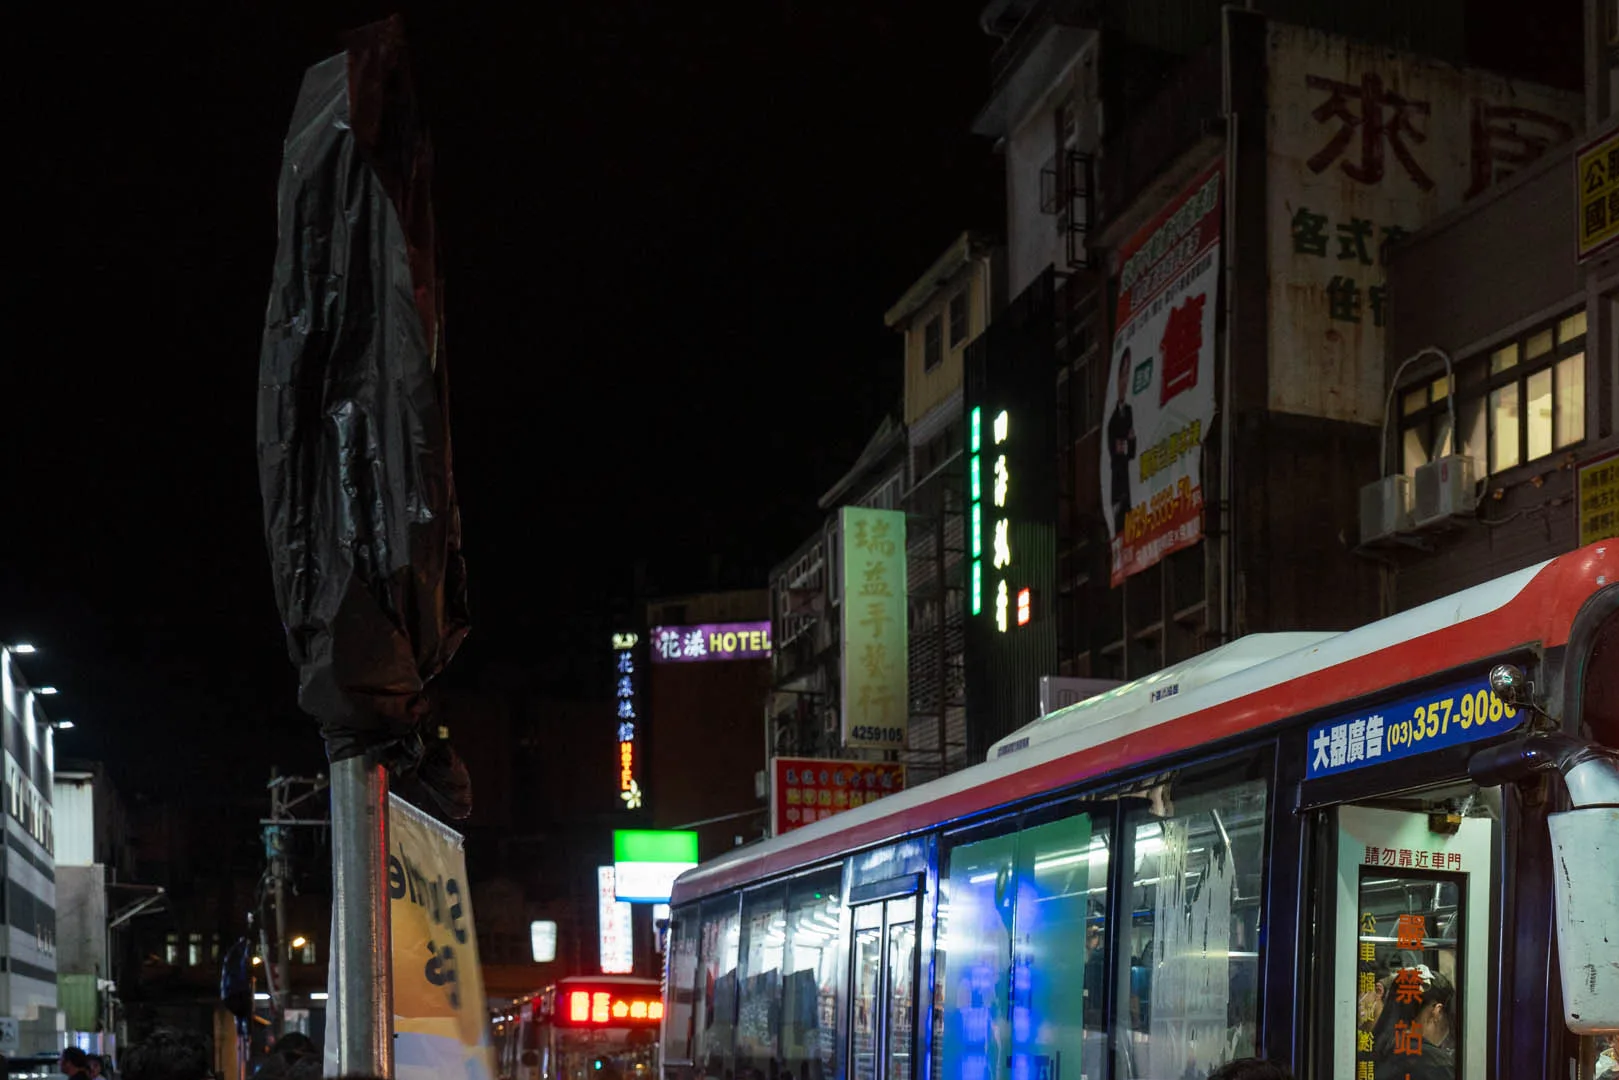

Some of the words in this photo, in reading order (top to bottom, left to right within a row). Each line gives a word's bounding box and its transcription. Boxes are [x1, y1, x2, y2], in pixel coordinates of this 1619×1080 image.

[710, 631, 771, 652] HOTEL
[1312, 715, 1384, 772] 大器廣告
[1365, 846, 1462, 871] 請勿靠近車門
